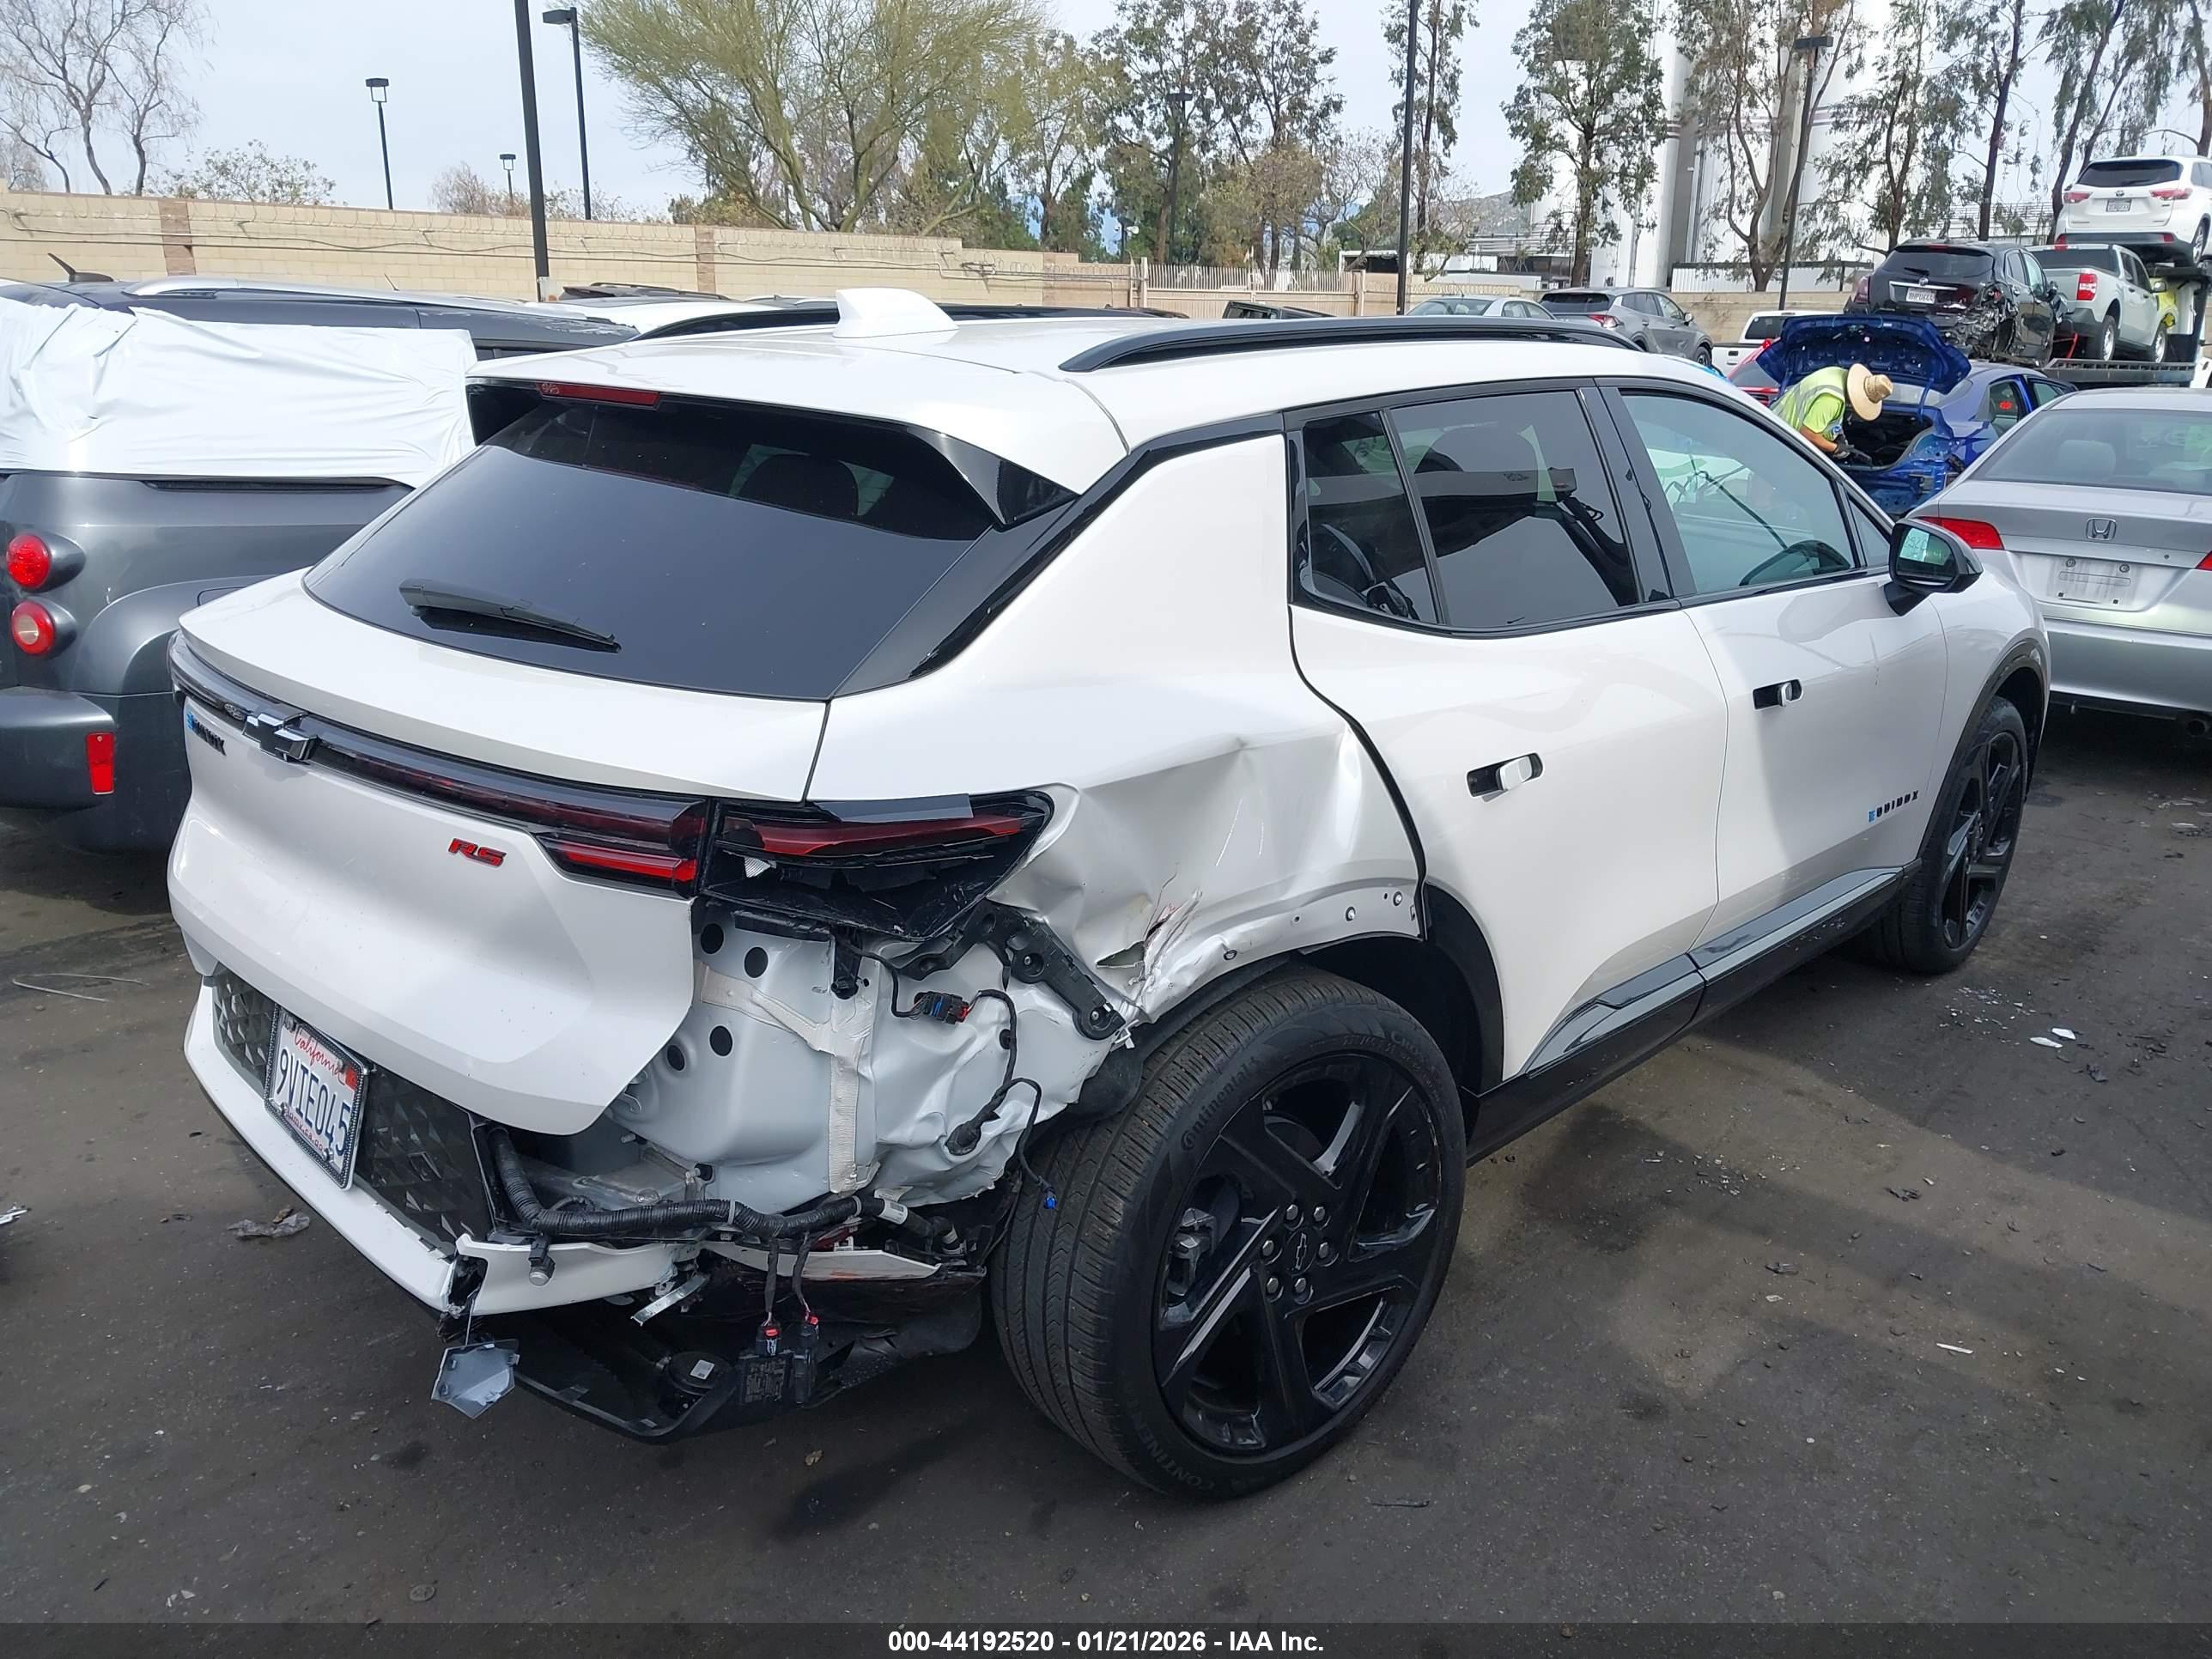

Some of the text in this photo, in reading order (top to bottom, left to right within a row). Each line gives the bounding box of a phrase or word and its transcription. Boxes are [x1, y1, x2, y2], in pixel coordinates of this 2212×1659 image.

[448, 837, 507, 867] RS
[295, 1025, 346, 1086] California
[276, 1048, 351, 1157] 9VIE045
[1181, 1066, 1250, 1152] Continental
